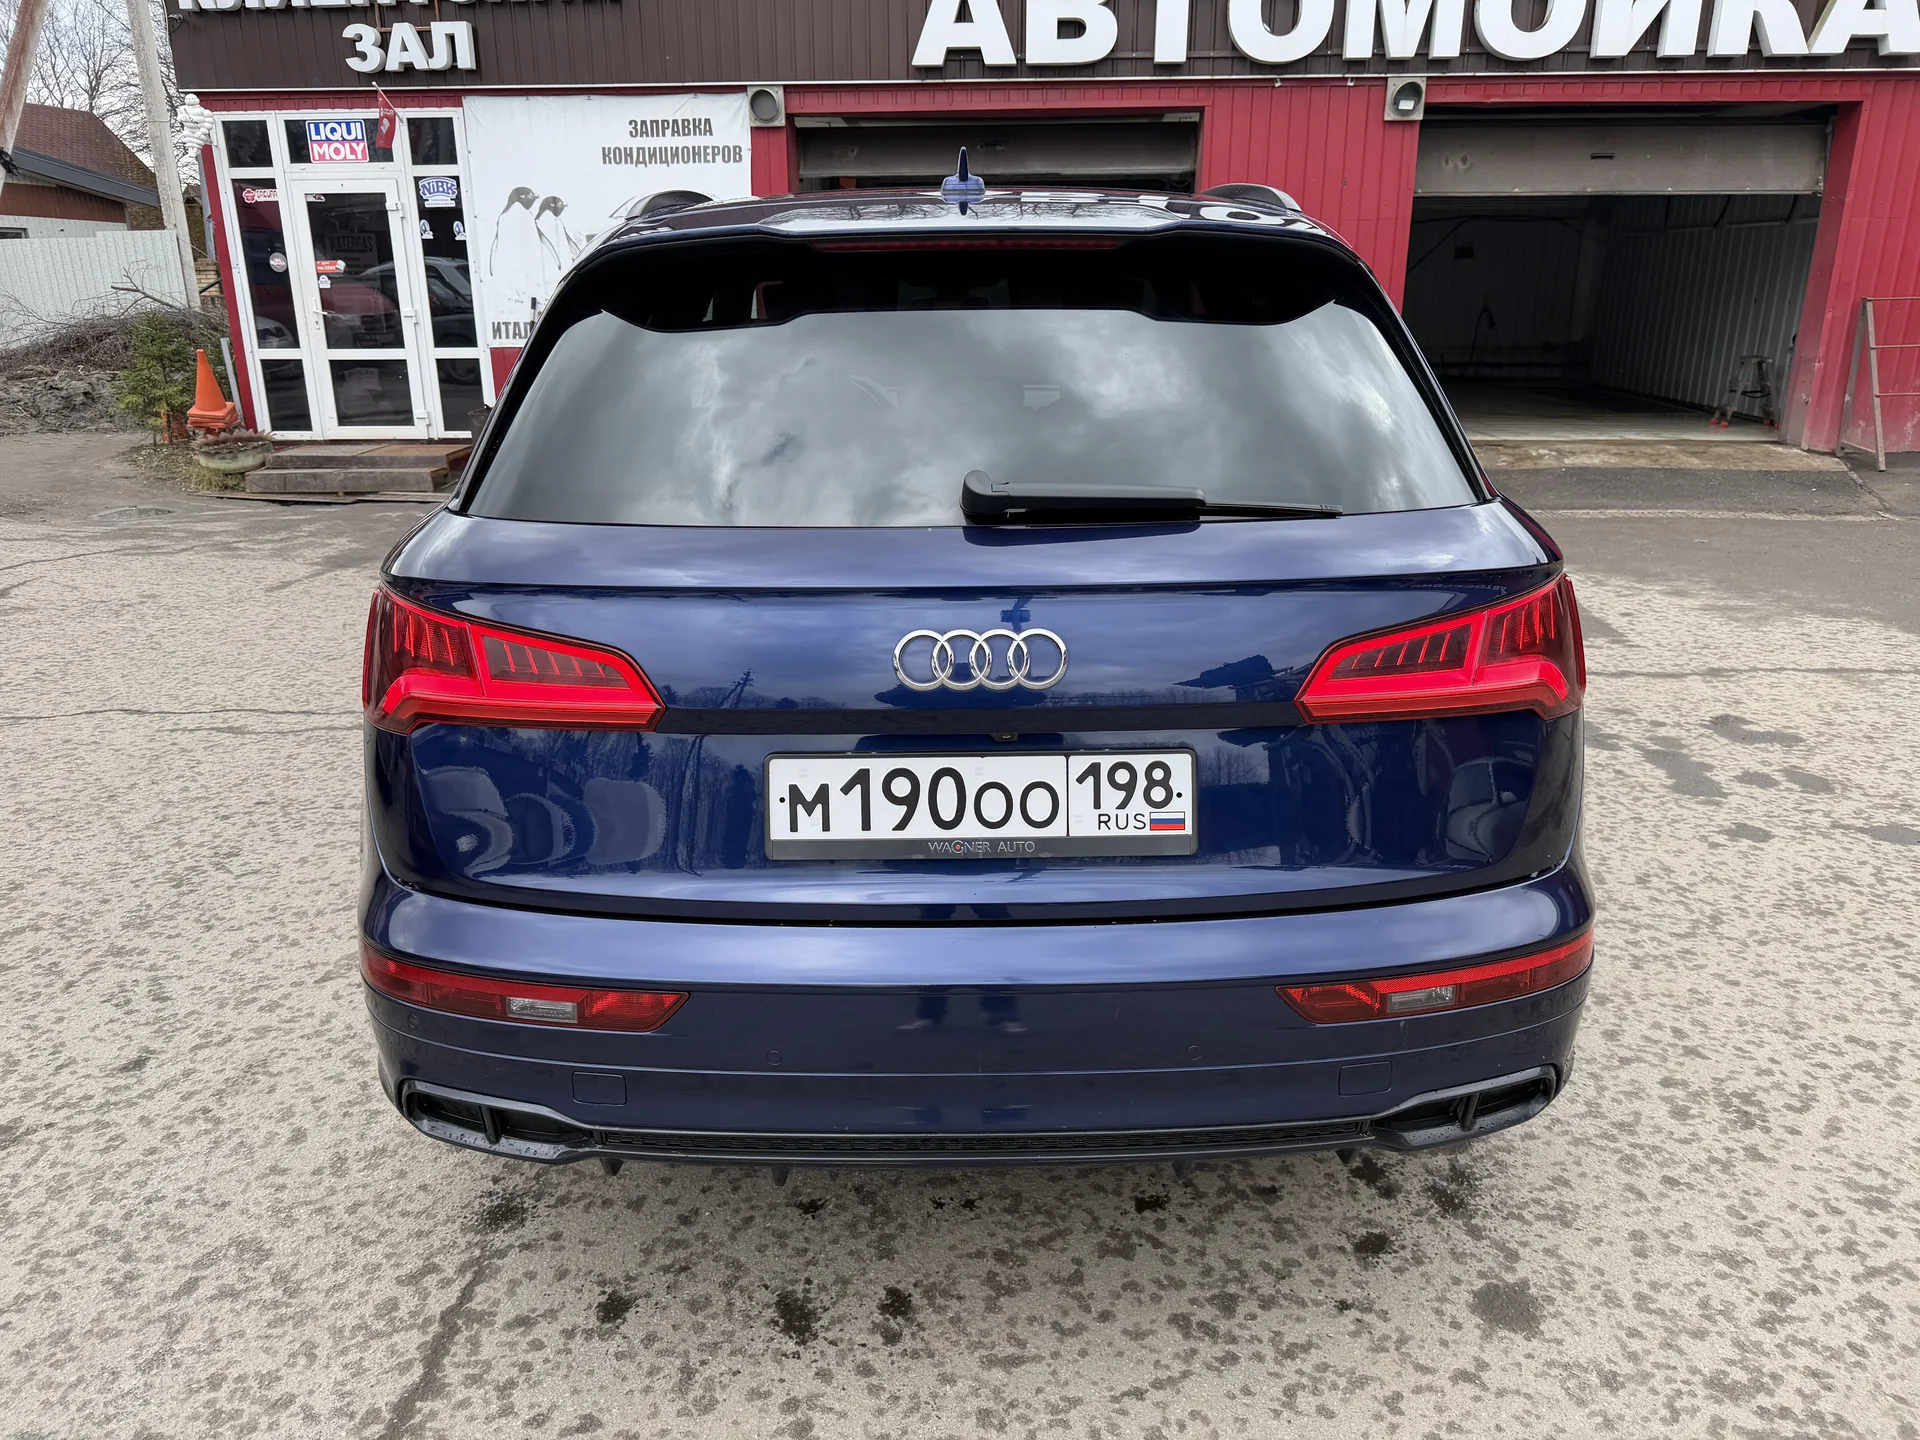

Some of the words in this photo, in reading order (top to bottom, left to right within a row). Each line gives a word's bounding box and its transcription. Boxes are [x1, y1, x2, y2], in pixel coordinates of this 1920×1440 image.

[342, 21, 476, 73] ЗАЛ
[309, 122, 364, 141] LIQUI
[628, 117, 714, 138] ЗАПРАВКА
[312, 143, 365, 161] MOLY
[601, 144, 743, 167] КОНДИЦИОНЕРОВ
[1075, 760, 1174, 810] 198
[1098, 813, 1146, 830] RUS
[928, 840, 991, 856] WAGNER
[997, 841, 1036, 853] AUTO
